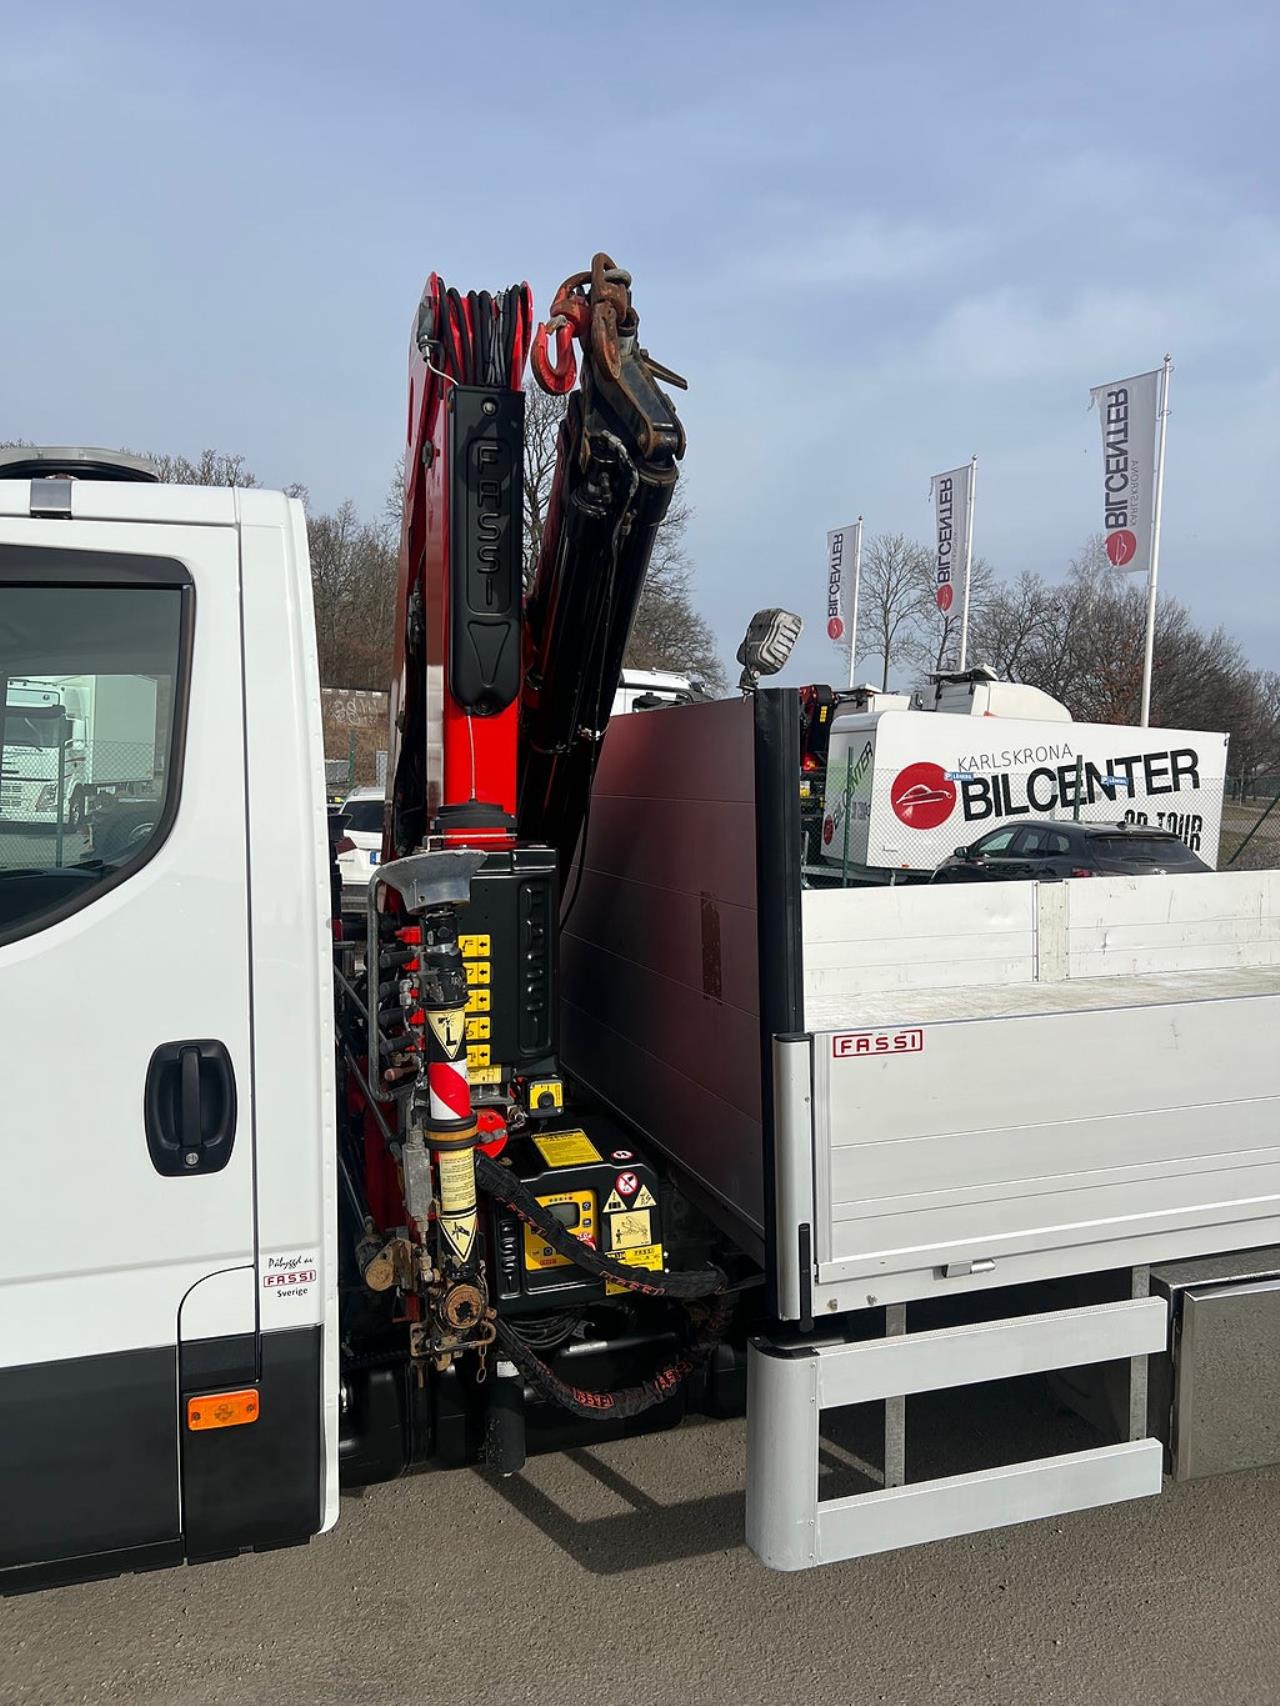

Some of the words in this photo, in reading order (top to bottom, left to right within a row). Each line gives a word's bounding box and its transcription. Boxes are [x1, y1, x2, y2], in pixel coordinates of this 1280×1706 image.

[477, 445, 502, 607] FASSI
[957, 743, 1073, 773] KARLSKRONA
[961, 748, 1201, 822] BILCENTER
[840, 1034, 916, 1054] FASSI
[267, 1271, 313, 1286] FASSI
[276, 1287, 308, 1298] Sverige
